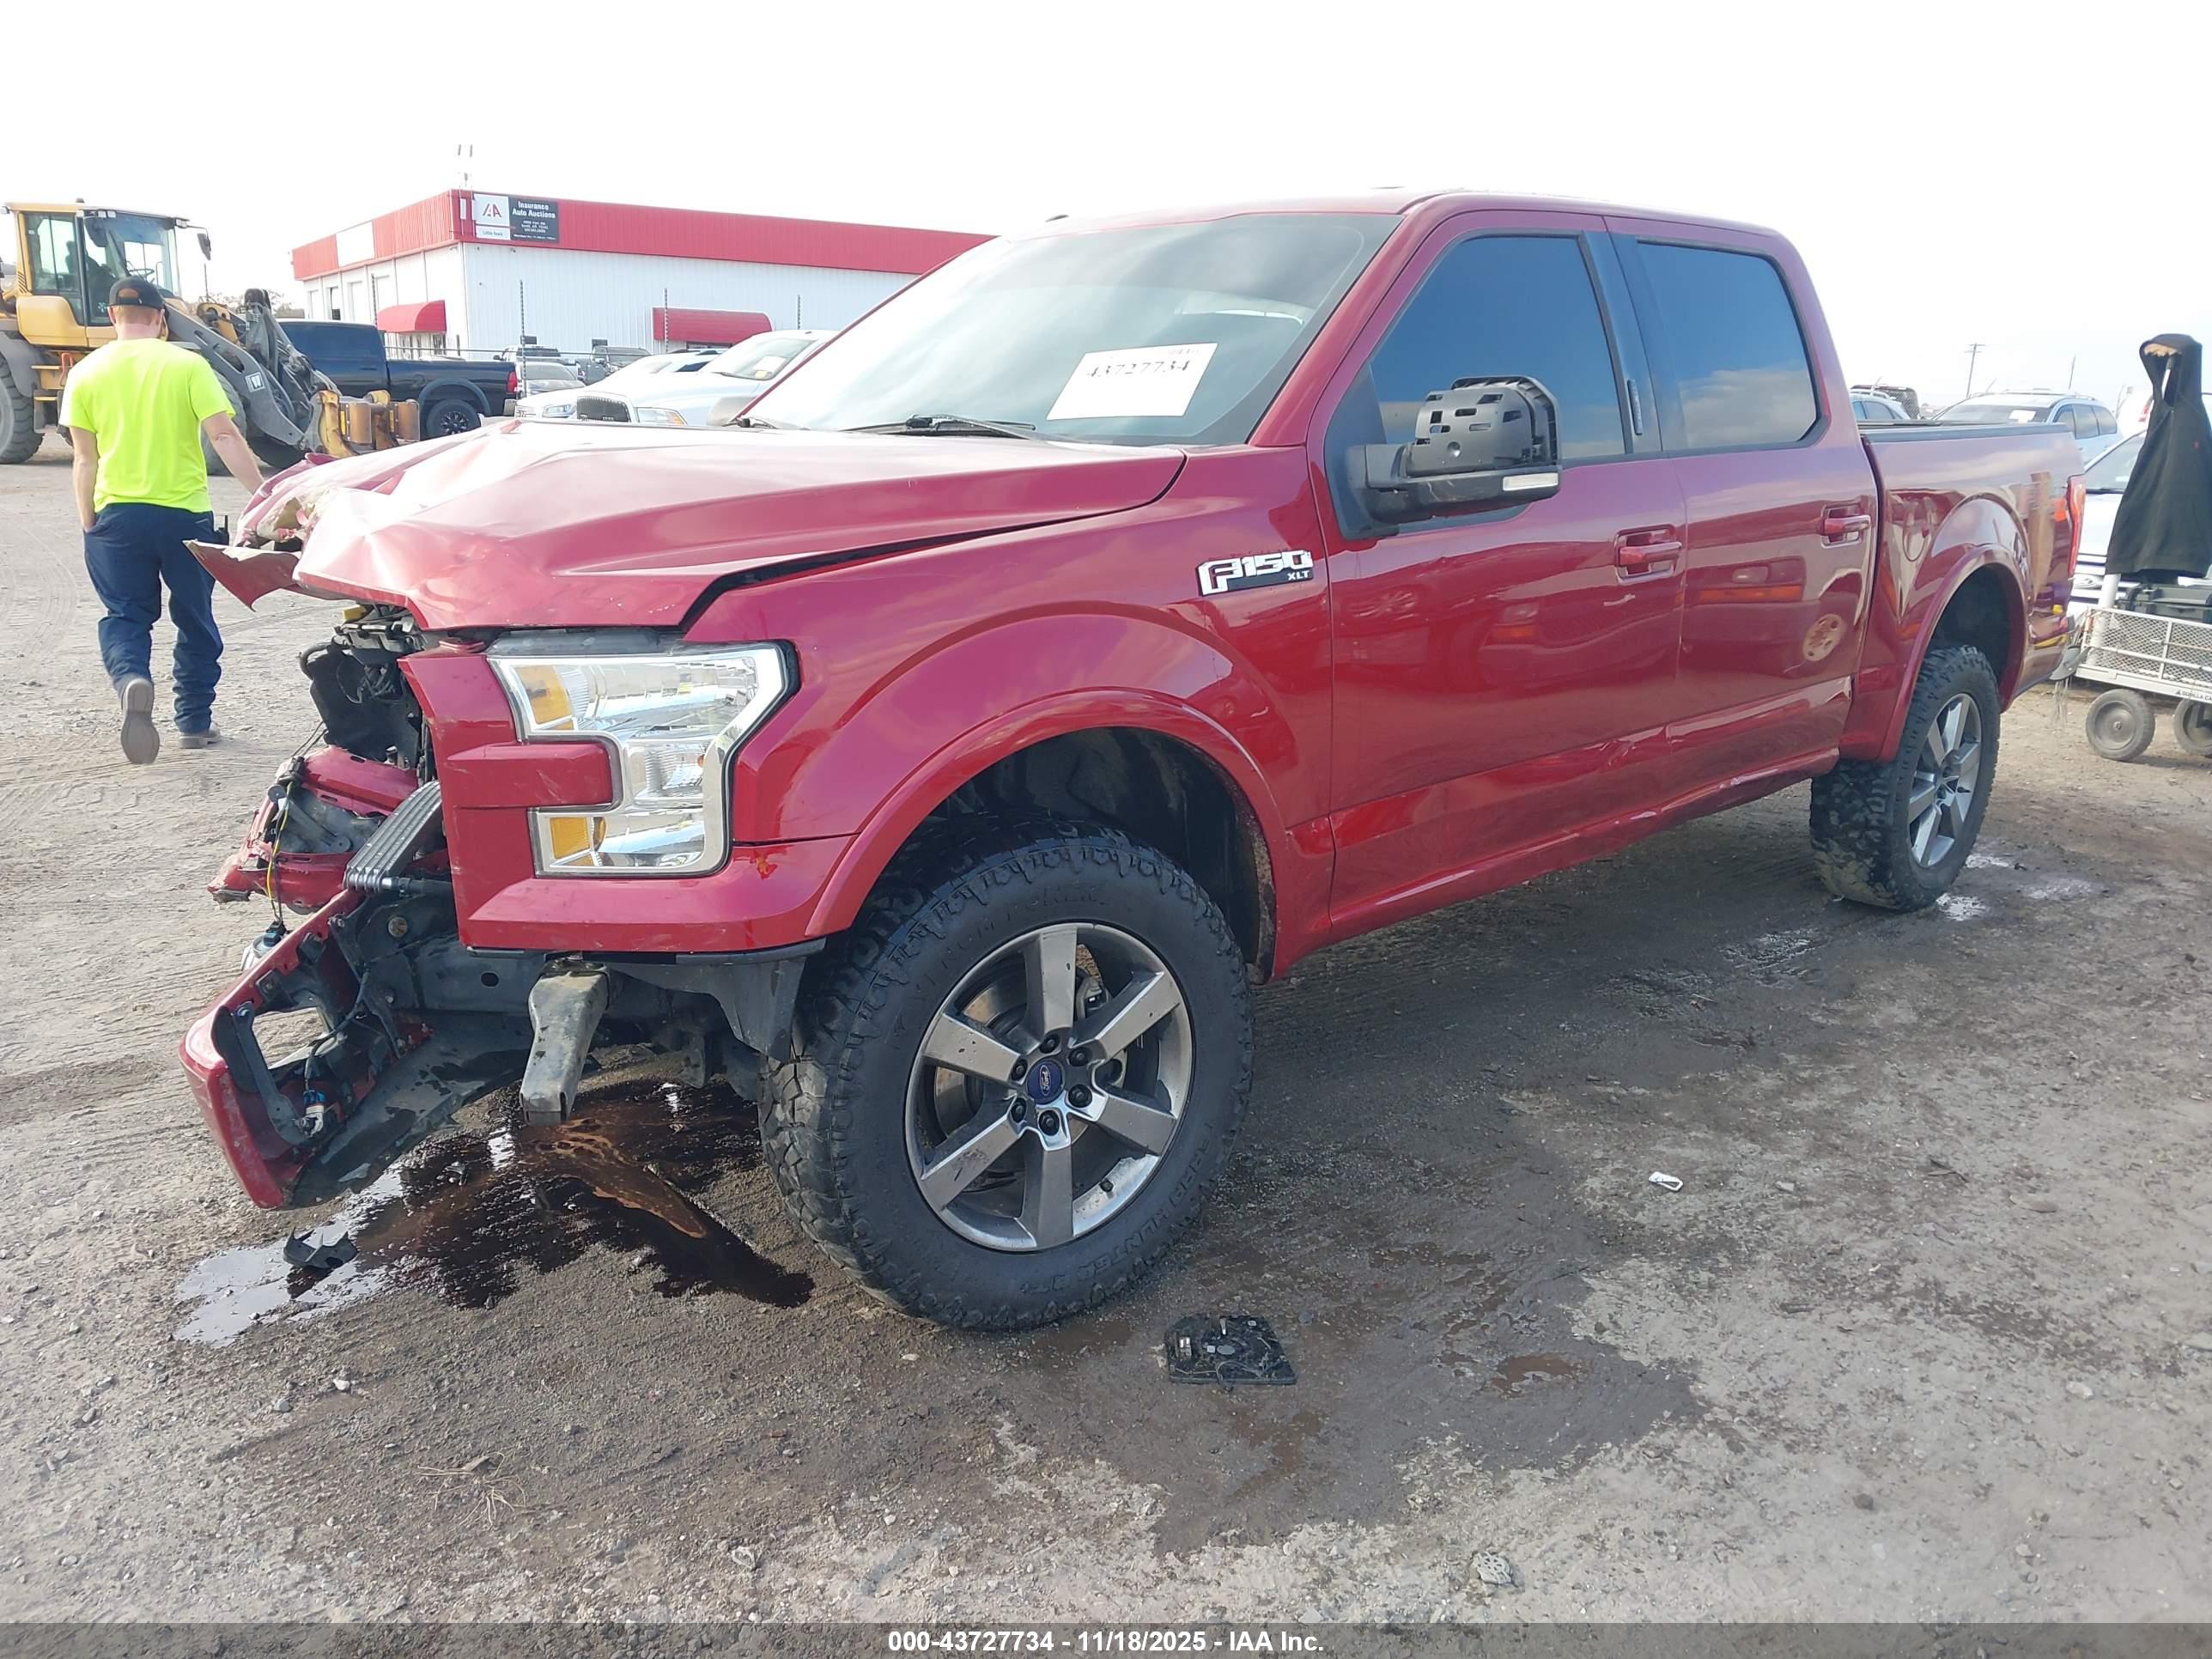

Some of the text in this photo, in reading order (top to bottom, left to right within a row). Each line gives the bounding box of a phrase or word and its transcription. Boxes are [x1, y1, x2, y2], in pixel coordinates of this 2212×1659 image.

[518, 201, 549, 210] Insurance
[512, 208, 556, 219] Auto Auctions
[1287, 570, 1310, 580] XLT
